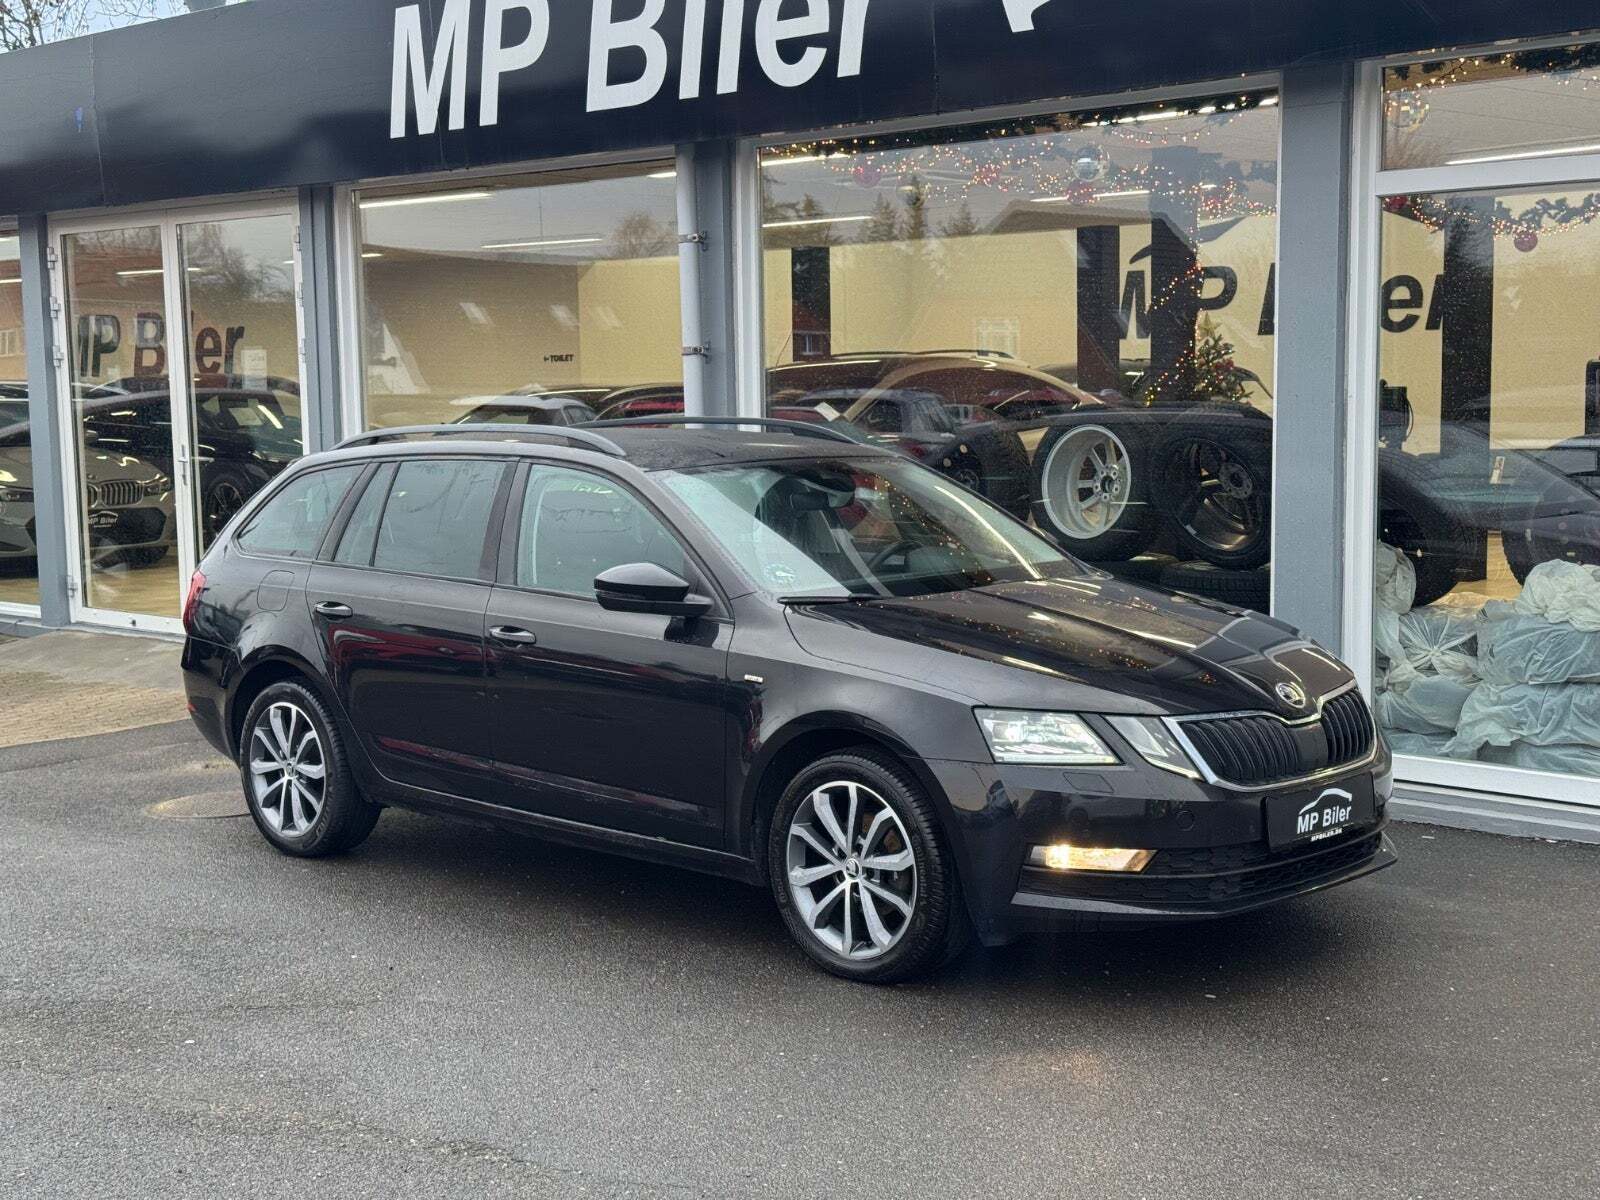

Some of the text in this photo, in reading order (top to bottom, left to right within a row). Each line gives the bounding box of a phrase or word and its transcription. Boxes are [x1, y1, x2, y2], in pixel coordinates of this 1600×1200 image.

[390, 0, 869, 139] MP Biler
[1297, 805, 1352, 834] MP Biler
